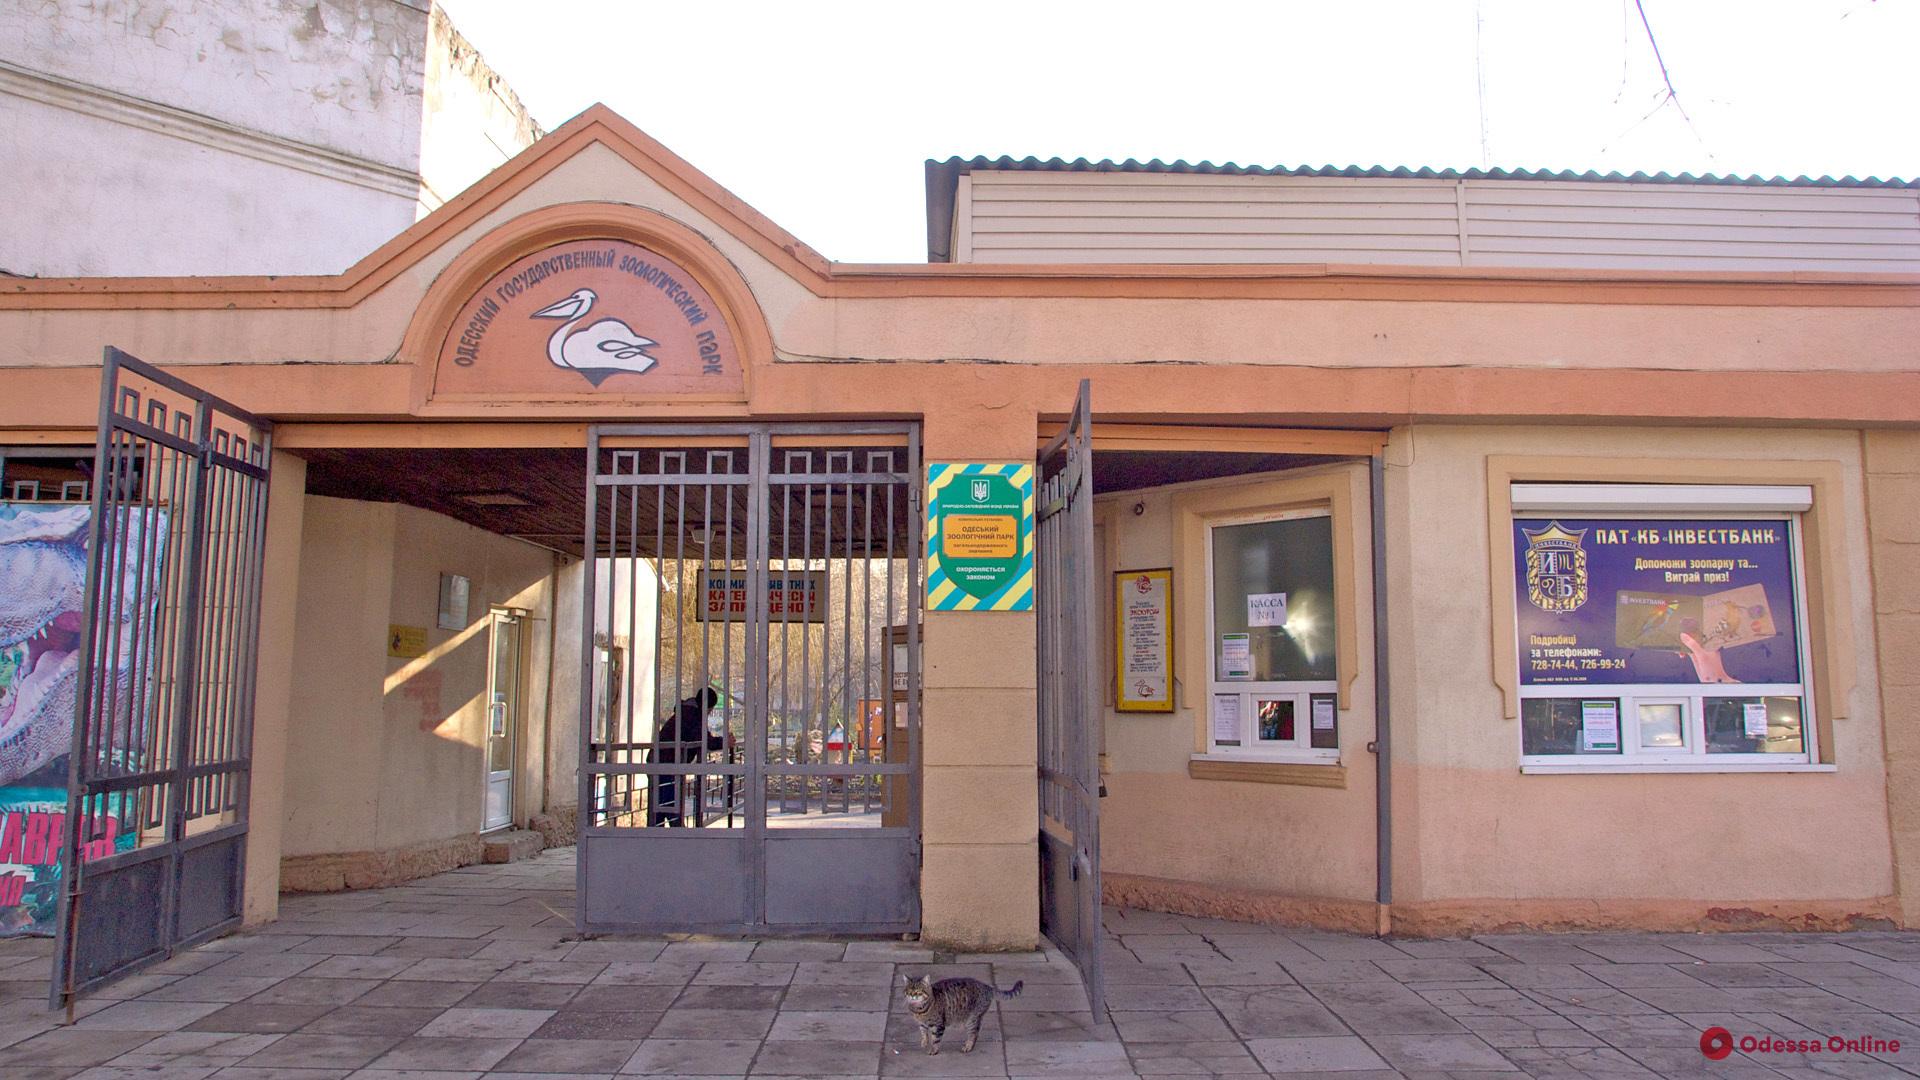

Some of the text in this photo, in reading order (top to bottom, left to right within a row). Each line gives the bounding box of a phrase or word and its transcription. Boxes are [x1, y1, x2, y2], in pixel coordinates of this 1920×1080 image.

[454, 296, 500, 367] ОДЕССКИЙ
[619, 255, 709, 327] ЗООЛОГИЧЕСКИЙ
[962, 525, 999, 533] ОДЕСЬКИЙ
[1596, 530, 1629, 545] ПАТ
[1634, 558, 1687, 571] Допоможи
[1690, 560, 1734, 570] зоопарку
[1665, 571, 1729, 584] Виграй приз!
[1250, 599, 1284, 608] КАССА
[1530, 634, 1577, 646] Подробиці
[1531, 647, 1602, 658] за телефонами:
[1531, 659, 1626, 670] 728-74-44, 726-99-24
